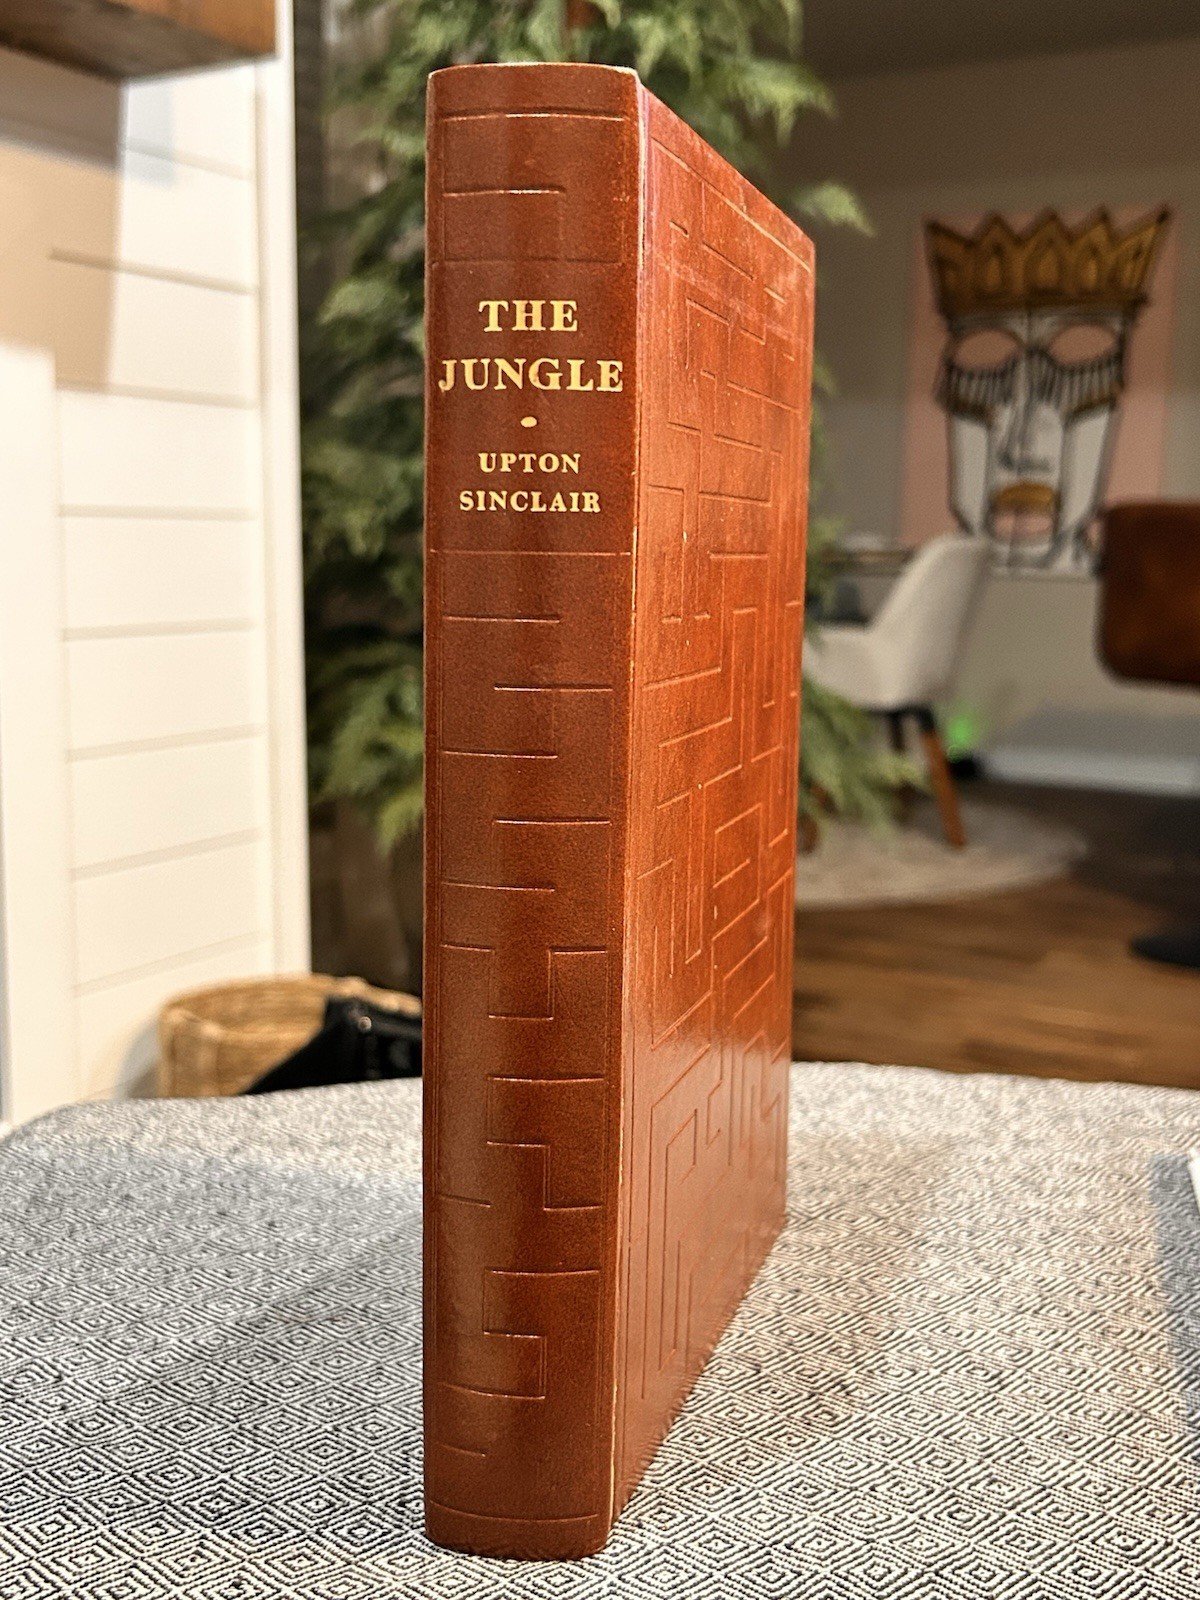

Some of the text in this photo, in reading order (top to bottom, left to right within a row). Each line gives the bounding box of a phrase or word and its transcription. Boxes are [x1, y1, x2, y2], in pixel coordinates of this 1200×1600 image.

[478, 300, 578, 332] THE
[438, 357, 624, 392] JUNGLE
[478, 453, 581, 474] UPTON
[459, 490, 601, 513] SINCLAIR
